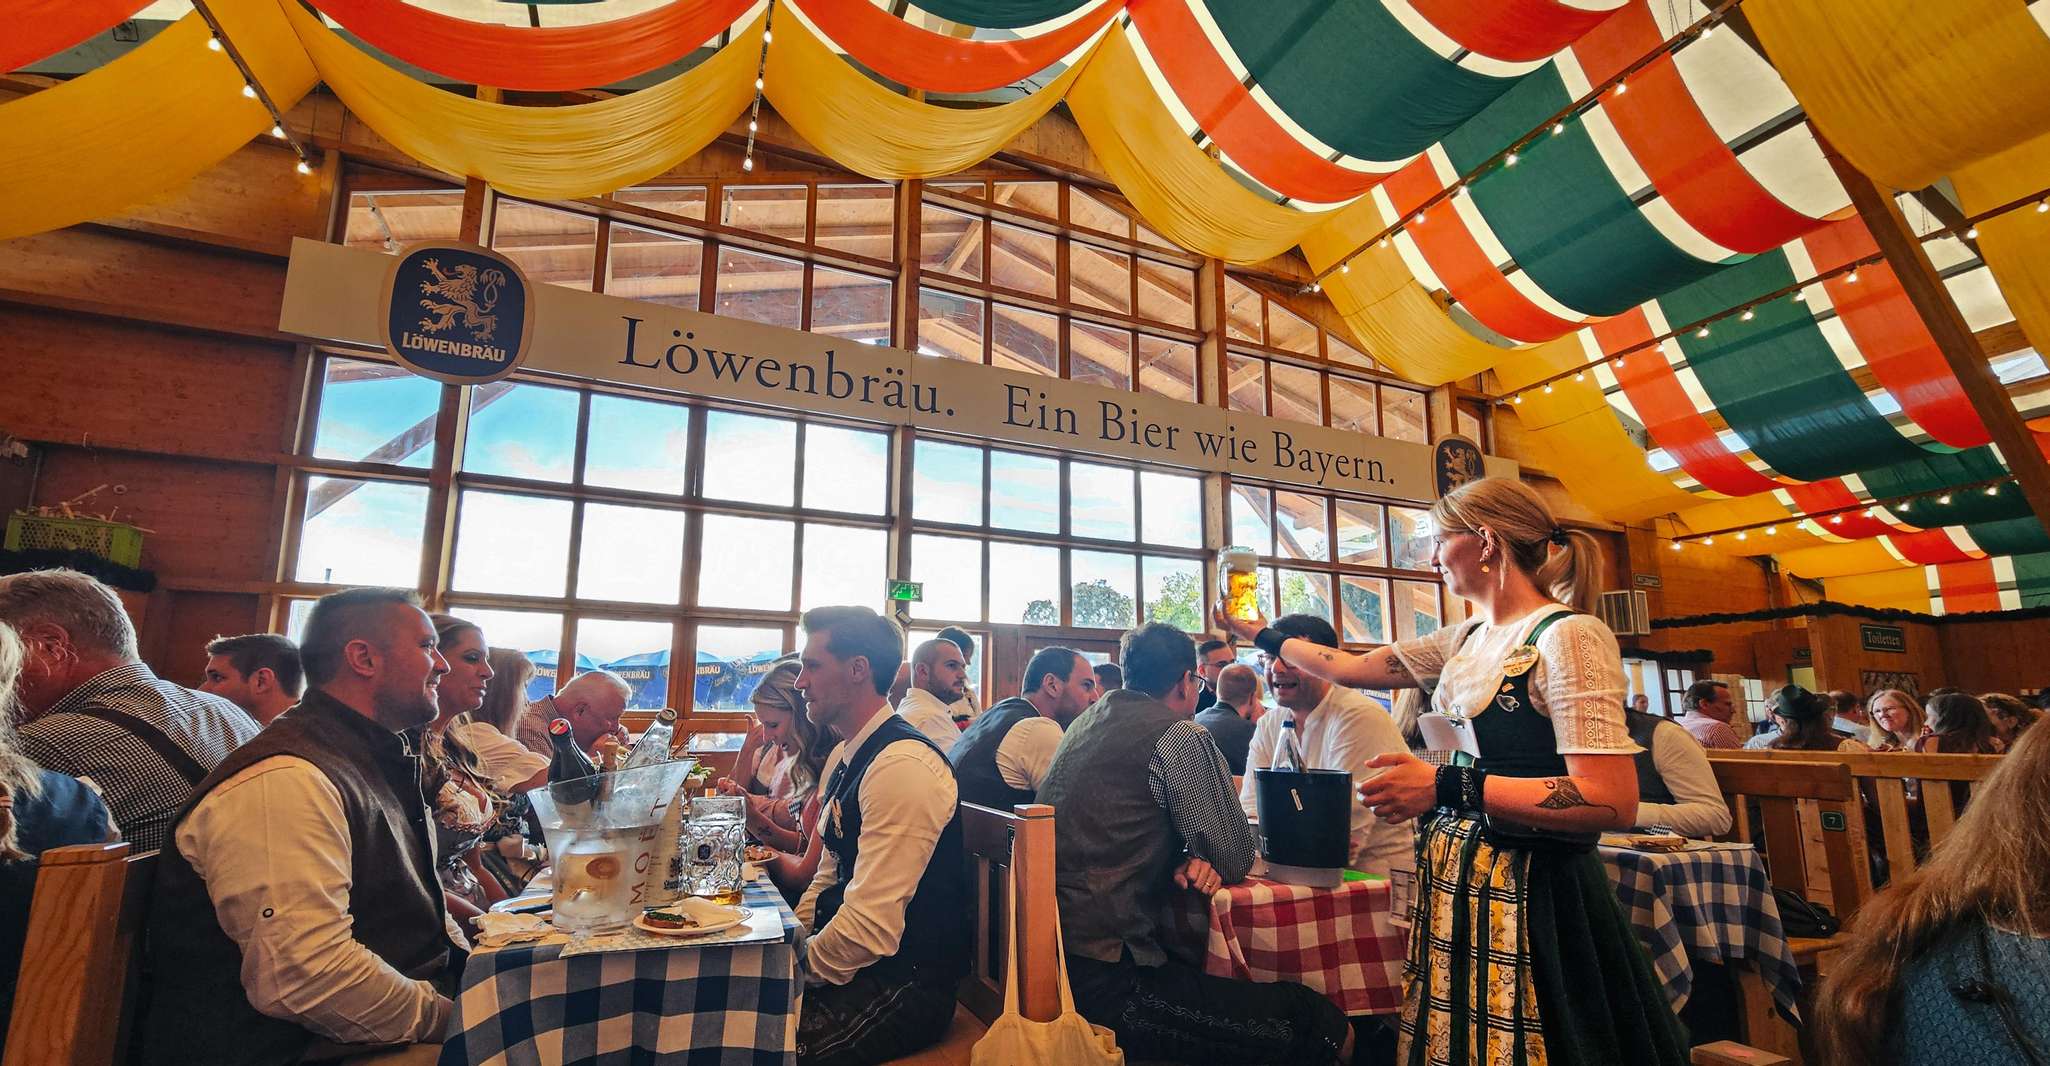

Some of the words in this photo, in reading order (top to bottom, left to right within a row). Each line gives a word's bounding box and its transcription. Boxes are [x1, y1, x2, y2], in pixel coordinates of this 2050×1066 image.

[402, 331, 506, 362] LÖWENBRÄU
[617, 315, 955, 417] Löwenbräu.
[1002, 383, 1080, 436] Ein
[1098, 400, 1180, 451] Bier
[1193, 425, 1257, 464] wie
[1271, 430, 1395, 486] Bayern.
